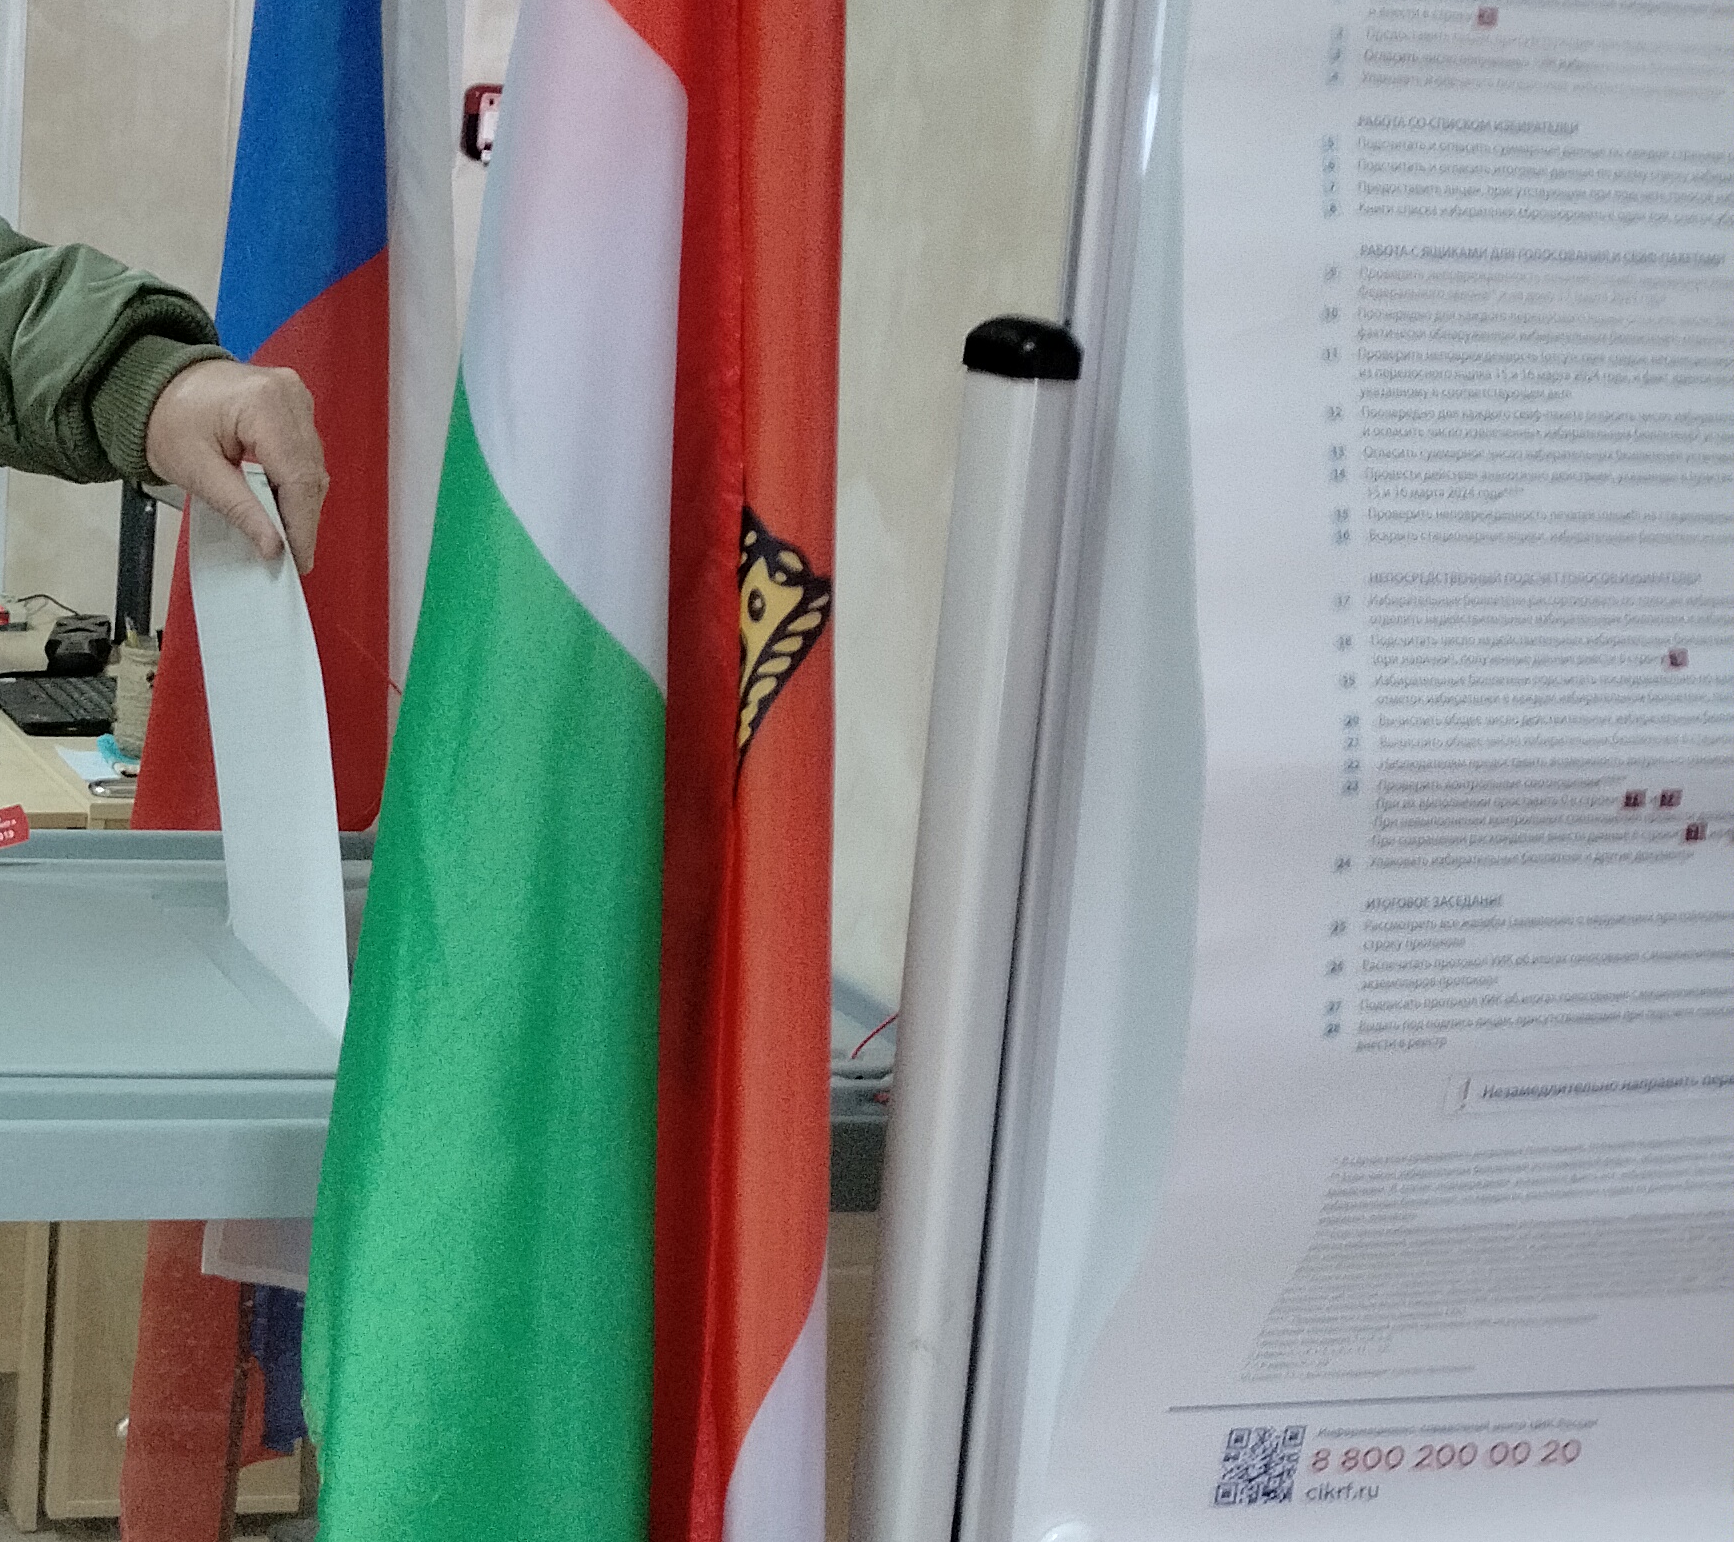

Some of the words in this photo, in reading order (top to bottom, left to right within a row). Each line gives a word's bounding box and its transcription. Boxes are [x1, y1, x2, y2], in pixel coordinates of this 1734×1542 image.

[1311, 1448, 1331, 1473] 8
[1340, 1445, 1405, 1472] 800
[1413, 1442, 1479, 1470] 200
[1488, 1440, 1532, 1467] 00
[1540, 1438, 1583, 1465] 20
[1305, 1480, 1380, 1503] cikrf.ru
